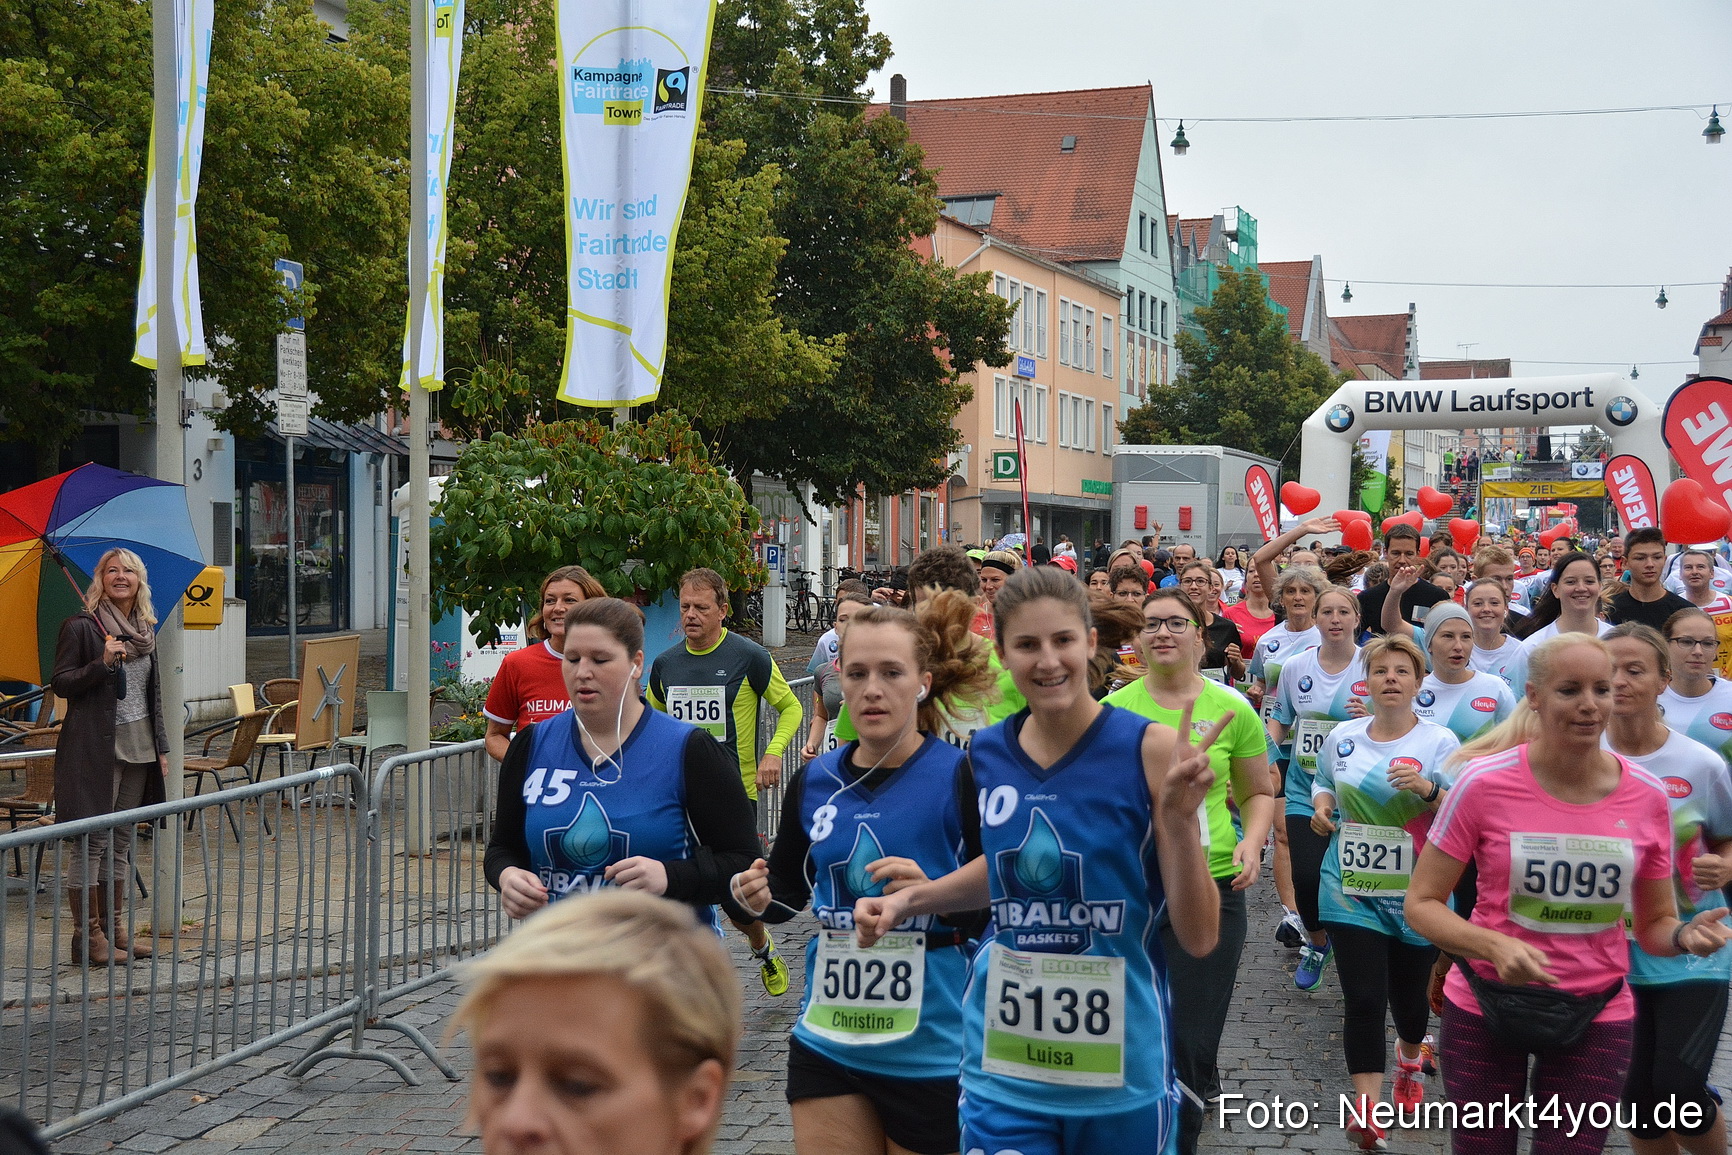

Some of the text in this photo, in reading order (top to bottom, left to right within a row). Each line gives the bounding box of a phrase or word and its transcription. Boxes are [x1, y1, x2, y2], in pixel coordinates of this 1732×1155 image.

[574, 68, 642, 85] Kampagne
[573, 197, 615, 220] Wir
[578, 230, 667, 255] Fairtrde
[578, 267, 638, 290] Stadt
[280, 344, 304, 357] Parkschein
[282, 357, 303, 369] werktags
[1364, 386, 1595, 415] BMW Laufsport
[193, 458, 203, 481] 3
[997, 456, 1016, 475] D
[1529, 484, 1557, 495] ZIEL
[769, 549, 777, 561] P
[672, 700, 720, 721] 5156
[1302, 733, 1328, 754] 50
[522, 768, 578, 805] 45
[809, 804, 838, 842] 8
[1367, 827, 1405, 839] BOCK
[1342, 840, 1402, 871] 5321
[1521, 844, 1559, 852] NeuerMarkt
[1566, 838, 1622, 853] BOCK
[1341, 869, 1382, 893] Peggy
[1523, 858, 1622, 899] 5093
[1539, 905, 1592, 921] Andrea
[1017, 933, 1079, 945] BASKETS
[1042, 958, 1111, 977] BOCK
[823, 958, 912, 1002] 5028
[999, 978, 1110, 1036] 5138
[832, 1010, 894, 1030] Christina
[1027, 1043, 1074, 1066] Luisa
